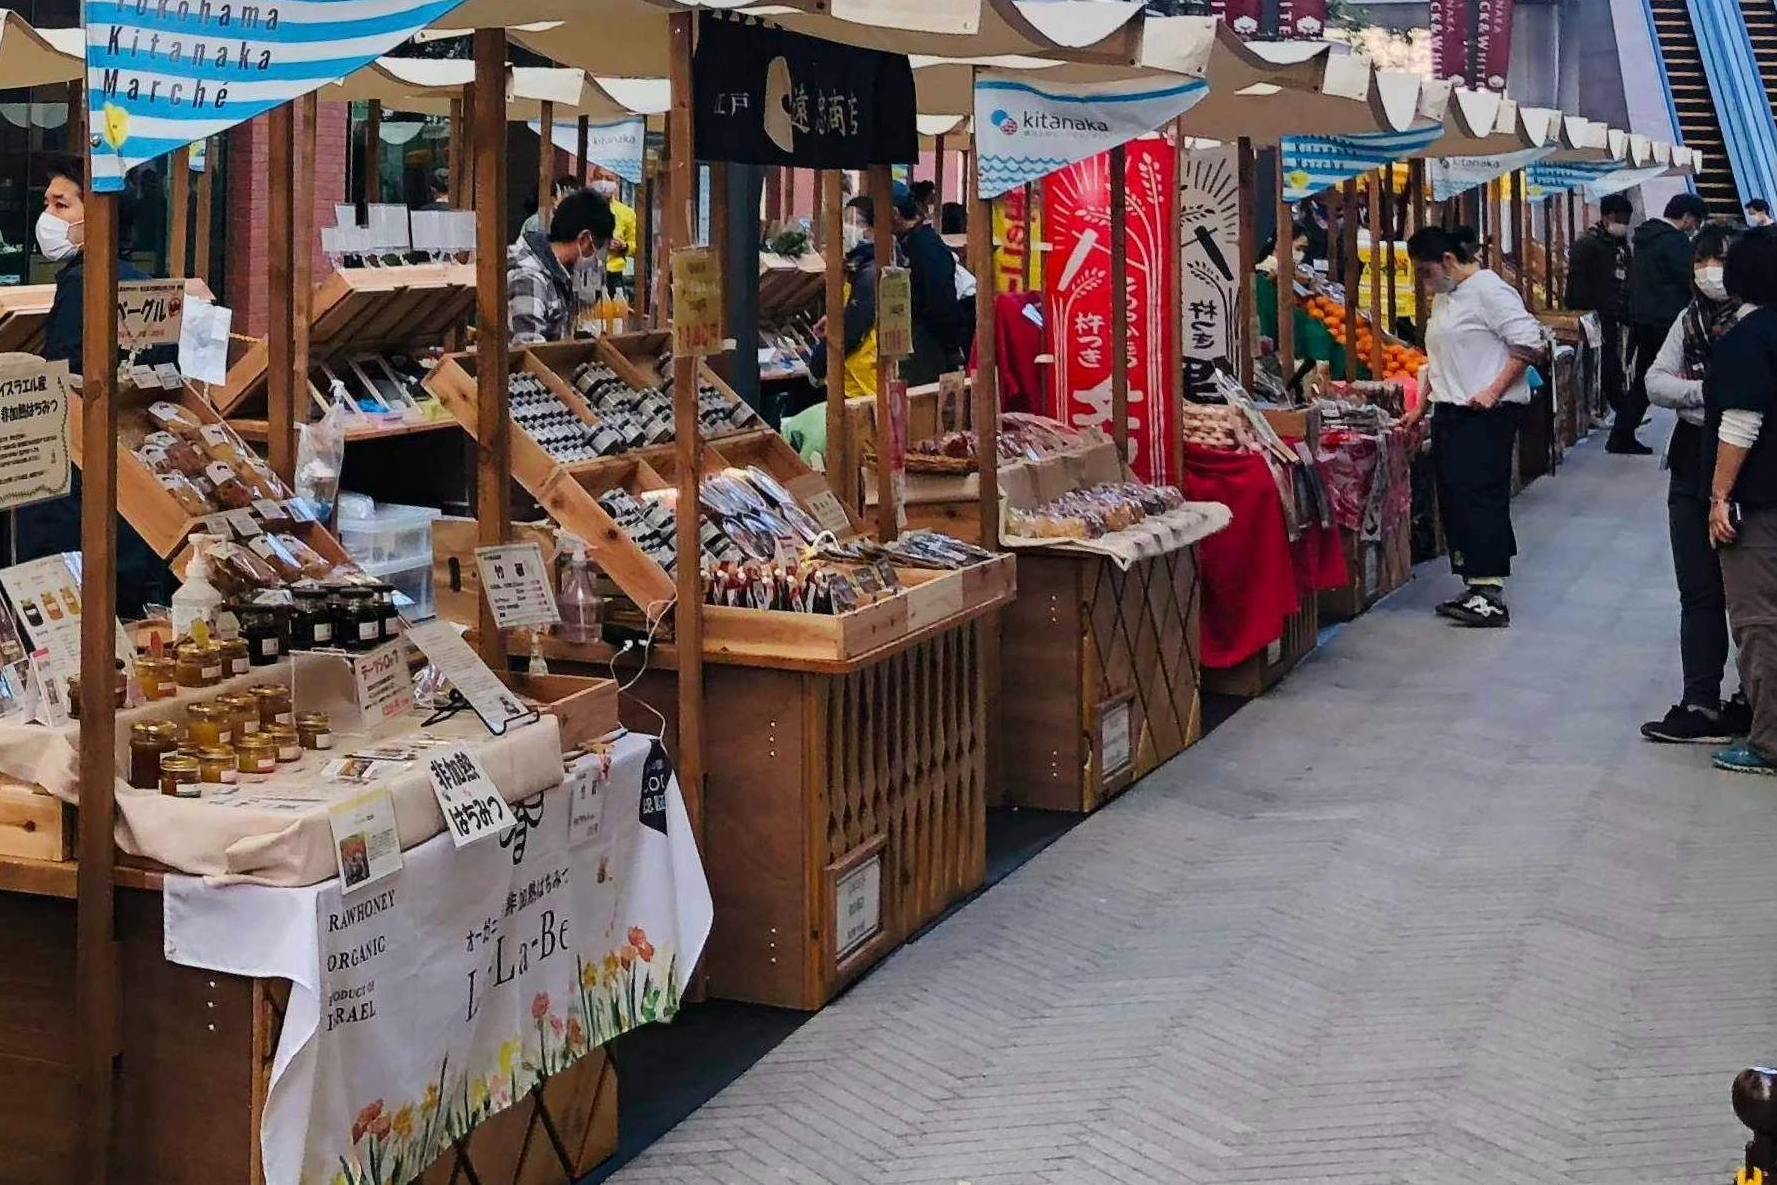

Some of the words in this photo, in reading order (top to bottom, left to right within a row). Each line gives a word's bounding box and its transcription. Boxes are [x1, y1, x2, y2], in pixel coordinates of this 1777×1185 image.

[107, 25, 272, 70] Kitanaka
[102, 67, 229, 109] Marché
[1023, 110, 1109, 132] kitanaka
[1074, 311, 1104, 369] 杵つき
[0, 399, 58, 423] 非加熱はちみつ
[430, 751, 481, 791] 非加熱
[447, 795, 502, 836] はちみつ
[329, 889, 397, 933] RAWHONEY
[327, 935, 387, 973] ORGANIC
[327, 1000, 377, 1032] IRAEL
